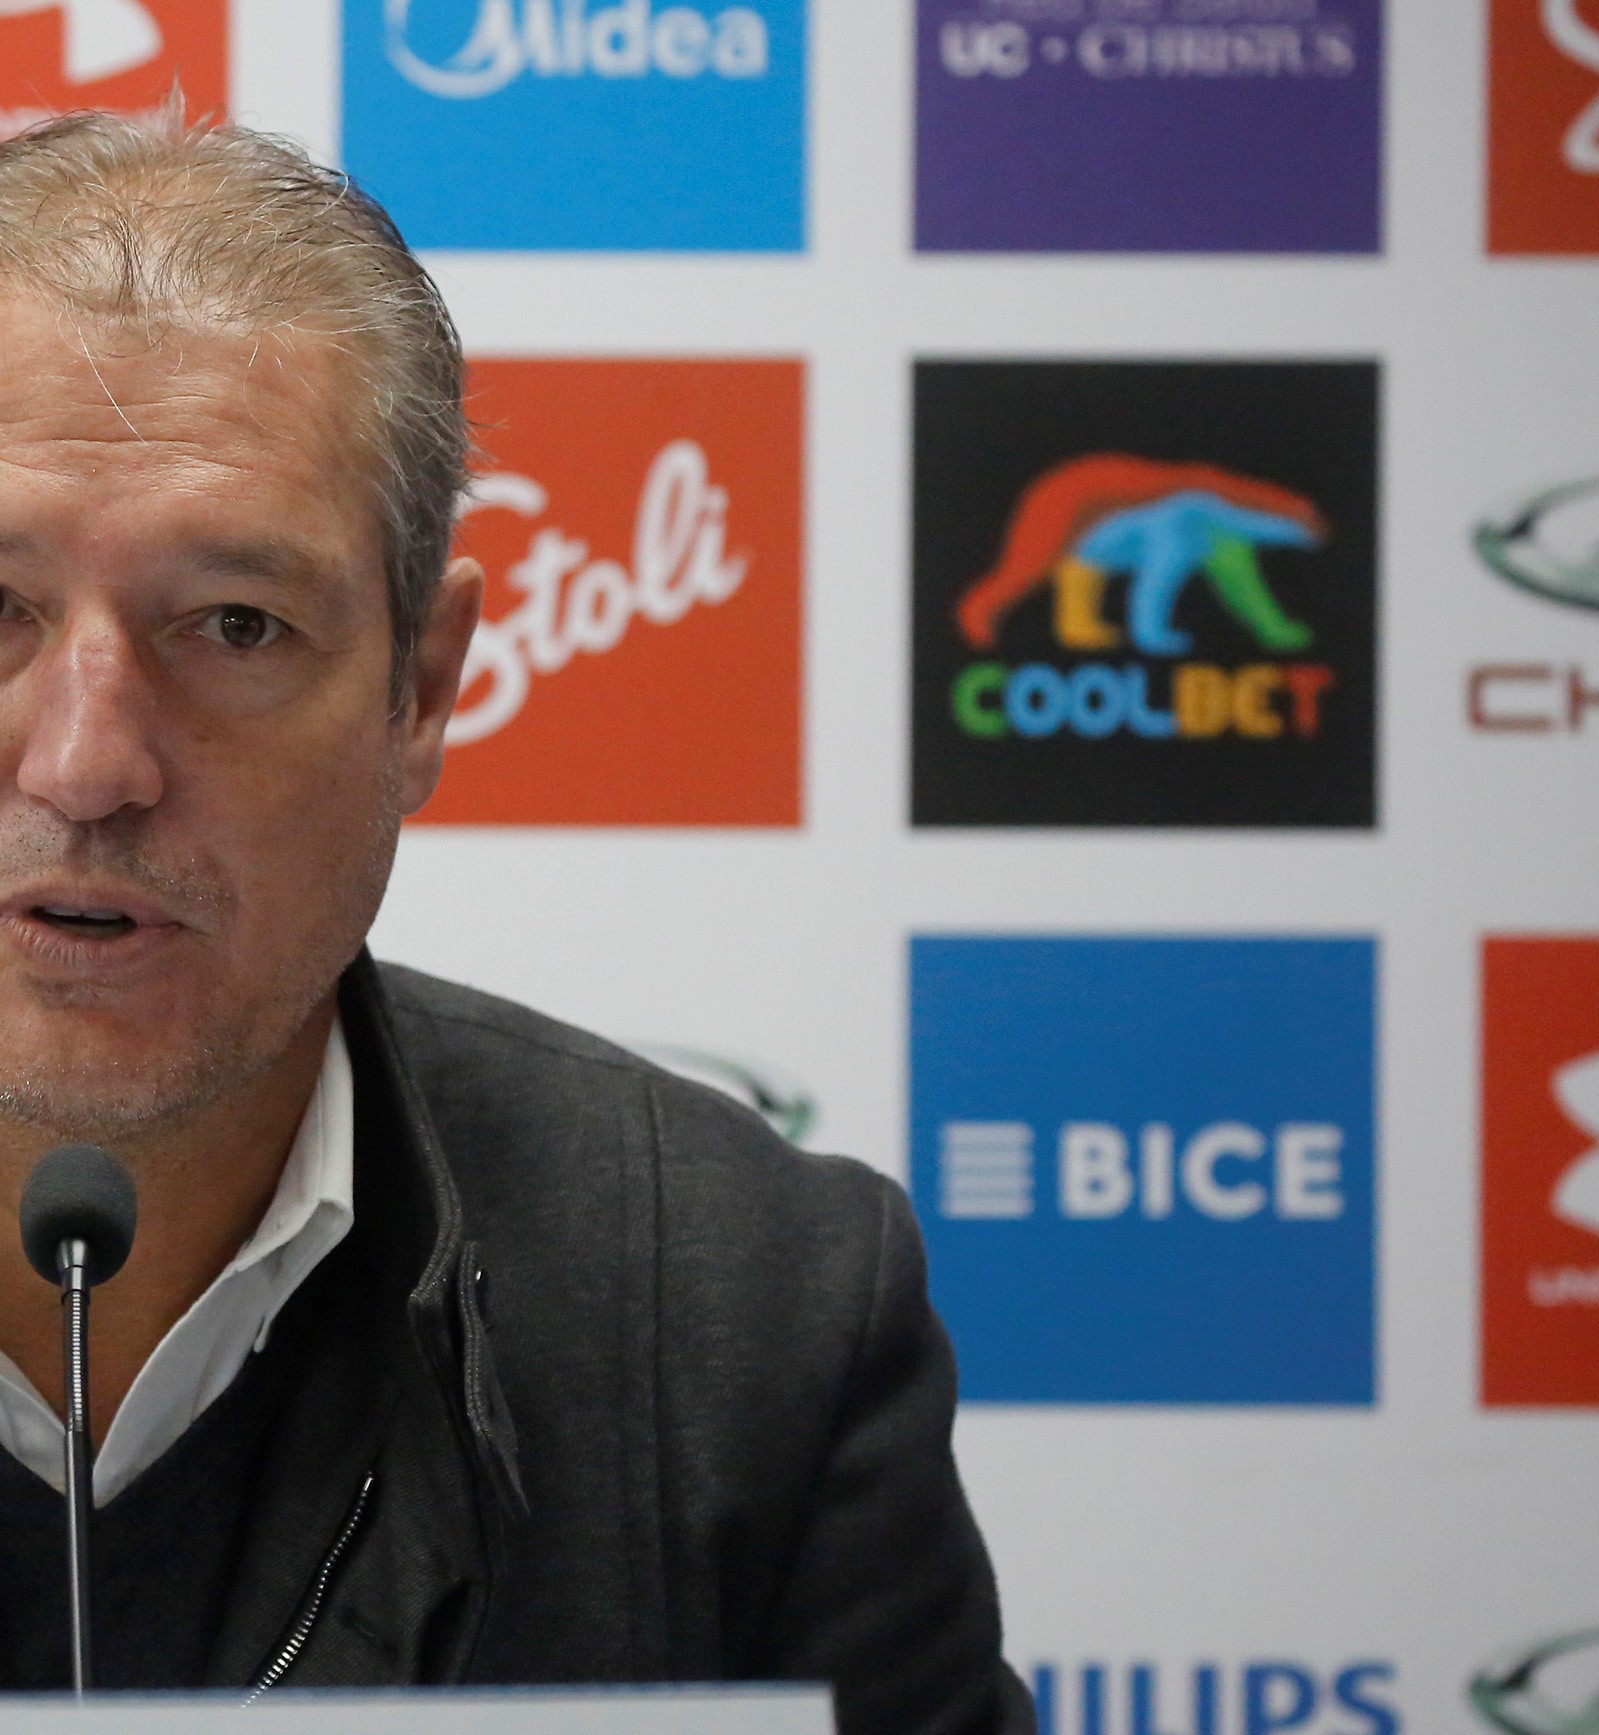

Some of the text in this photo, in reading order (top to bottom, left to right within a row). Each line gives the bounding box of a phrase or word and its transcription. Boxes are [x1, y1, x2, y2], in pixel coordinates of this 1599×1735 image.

[951, 664, 1333, 738] COOLBET
[1058, 1122, 1345, 1220] BICE
[1033, 1661, 1404, 1735] ILIPS
